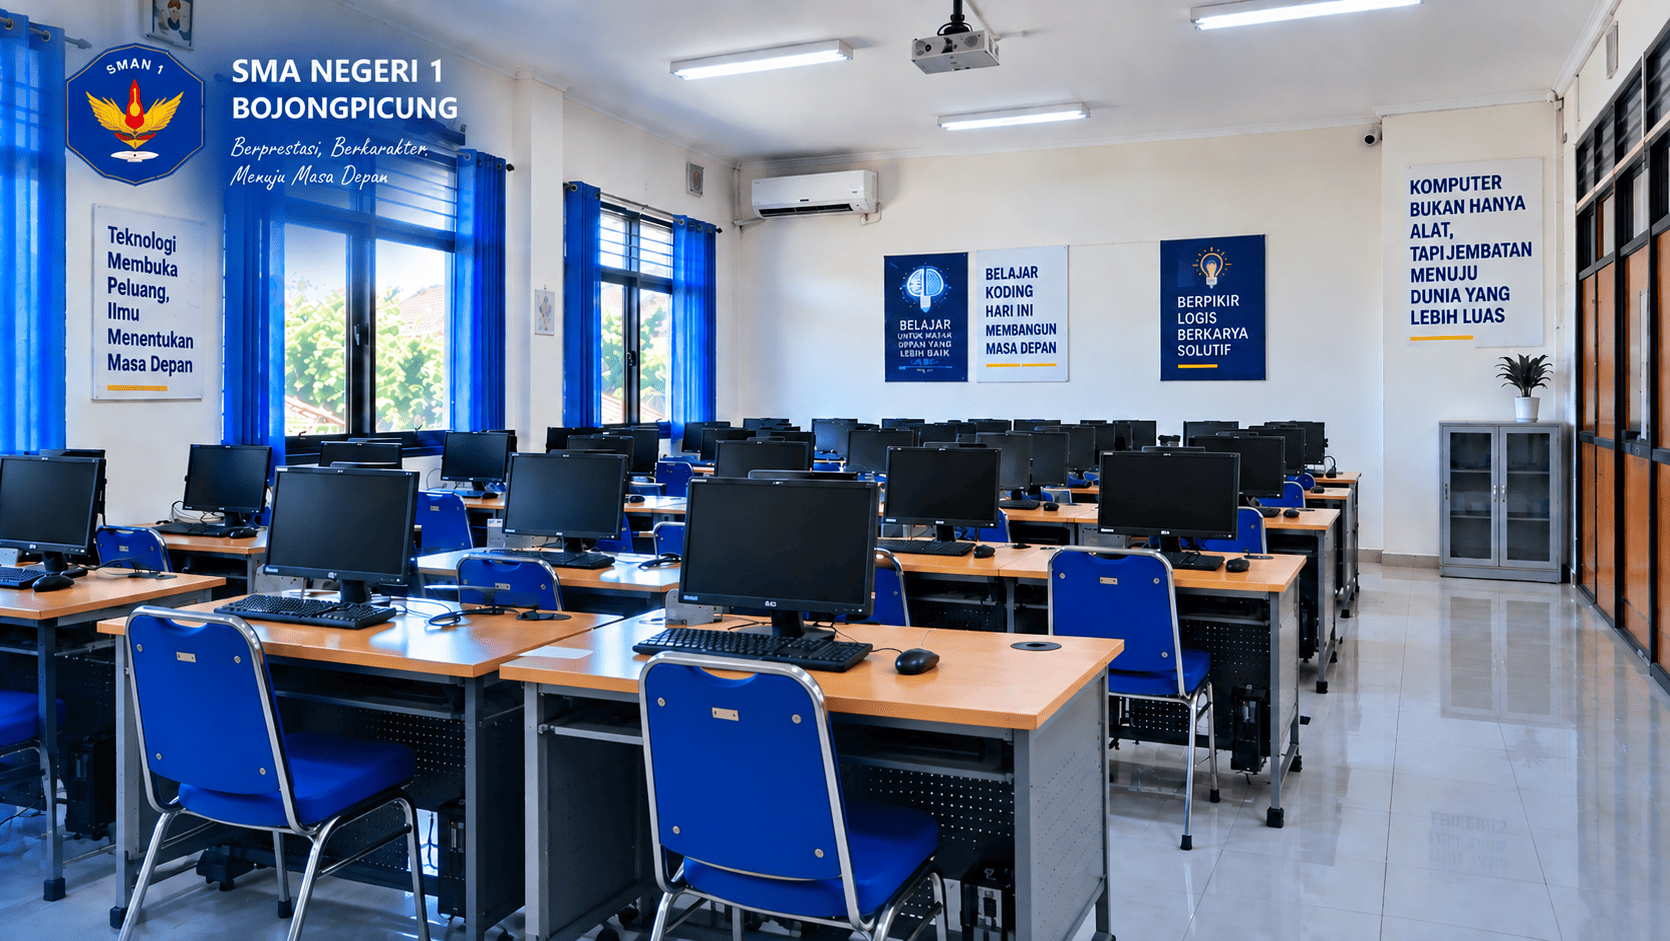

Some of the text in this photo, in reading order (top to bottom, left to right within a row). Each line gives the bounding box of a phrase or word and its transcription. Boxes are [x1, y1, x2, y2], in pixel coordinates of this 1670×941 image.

[1410, 174, 1502, 195] KOMPUTER
[1410, 194, 1527, 218] BUKAN HANYA
[1409, 221, 1455, 241] ALAT,
[107, 225, 177, 257] Teknologi
[1409, 241, 1533, 262] TAPI JEMBATAN
[107, 251, 178, 278] Membuka
[985, 265, 1039, 281] BELAJAR
[1410, 265, 1478, 284] MENUJU
[107, 276, 171, 305] Peluang,
[985, 284, 1034, 300] KODING
[1410, 285, 1511, 305] DUNIA YANG
[985, 303, 1034, 318] HARI INI
[1177, 294, 1240, 308] BERPIKIR
[107, 301, 140, 322] Ilmu
[1177, 311, 1217, 325] LOGIS
[1410, 307, 1506, 326] LEBIH LUAS
[899, 319, 952, 331] BELAJAR
[985, 322, 1057, 337] MEMBANGUN
[1177, 327, 1249, 341] BERKARYA
[107, 327, 195, 350] Menentukan
[928, 340, 952, 348] YANG
[985, 341, 1057, 355] MASA DEPAN
[1177, 343, 1232, 357] SOLUTIF
[107, 352, 193, 378] Masa Depan
